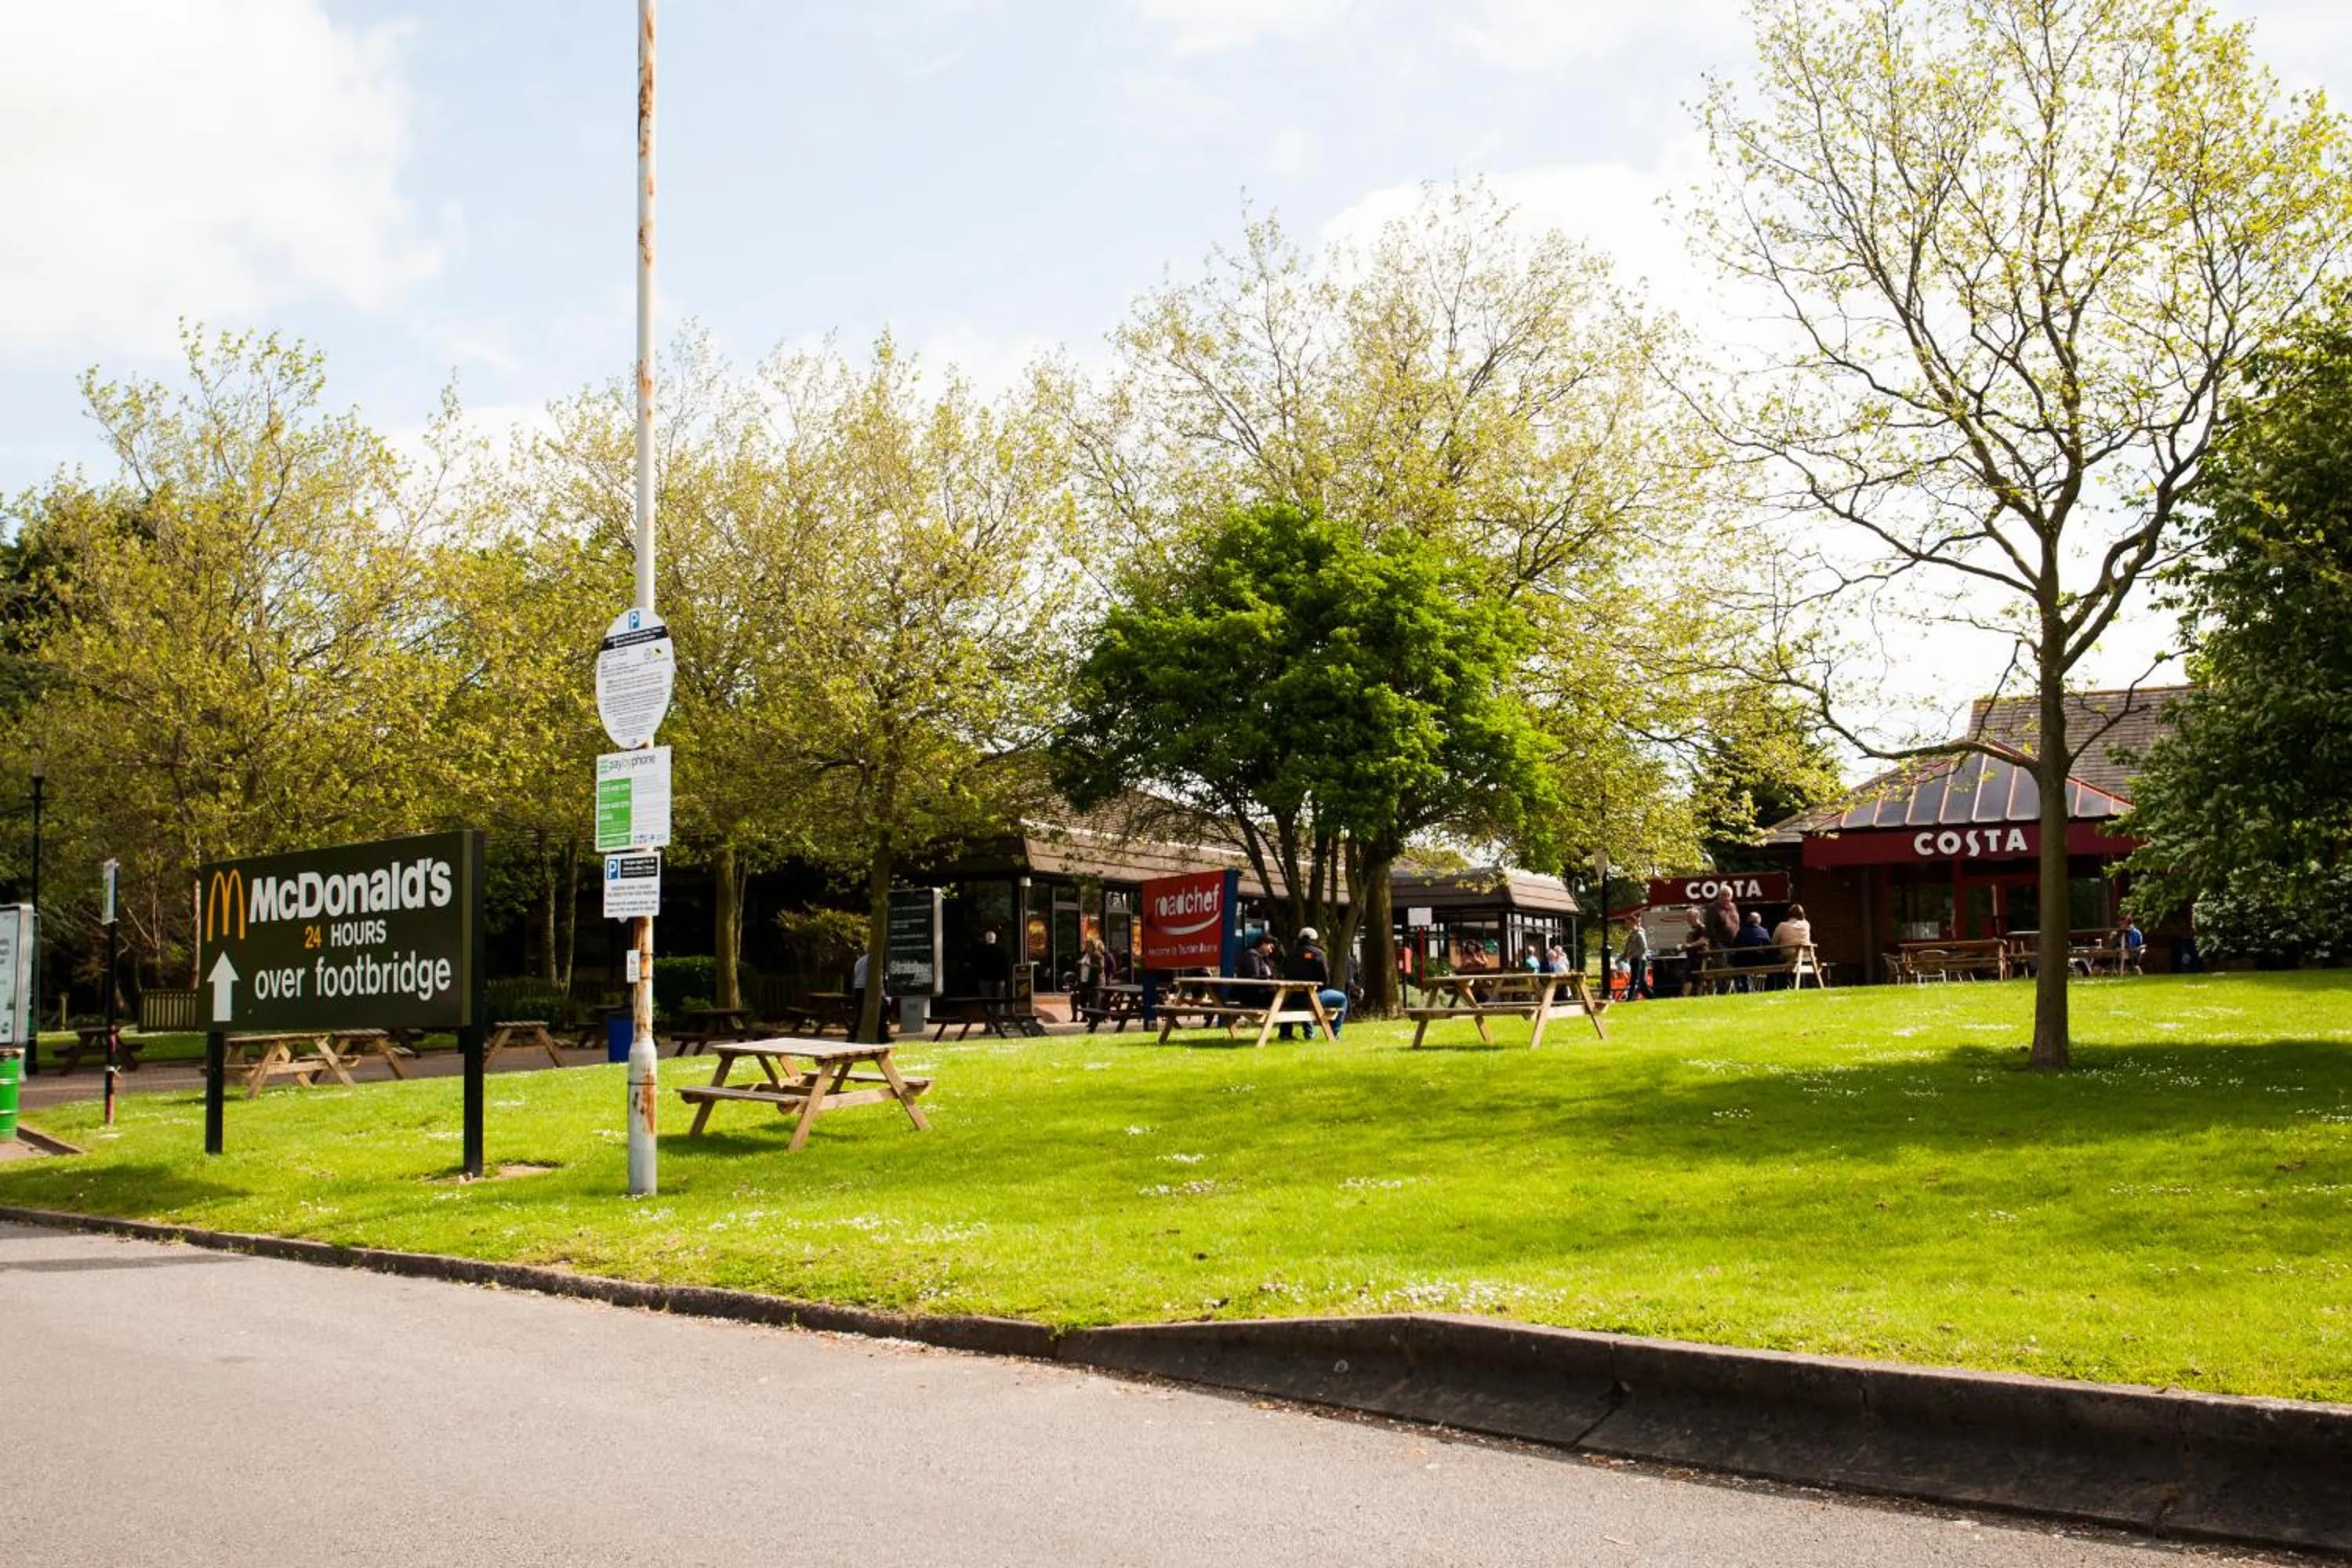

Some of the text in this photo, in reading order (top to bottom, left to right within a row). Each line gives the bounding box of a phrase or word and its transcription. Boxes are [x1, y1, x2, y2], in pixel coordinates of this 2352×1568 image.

[1913, 827, 2029, 858] COSTA
[608, 860, 617, 879] P
[248, 857, 453, 924] McDonald's
[1154, 883, 1221, 917] roadchef
[304, 919, 387, 949] 24 HOURS
[254, 949, 452, 1002] over footbridge
